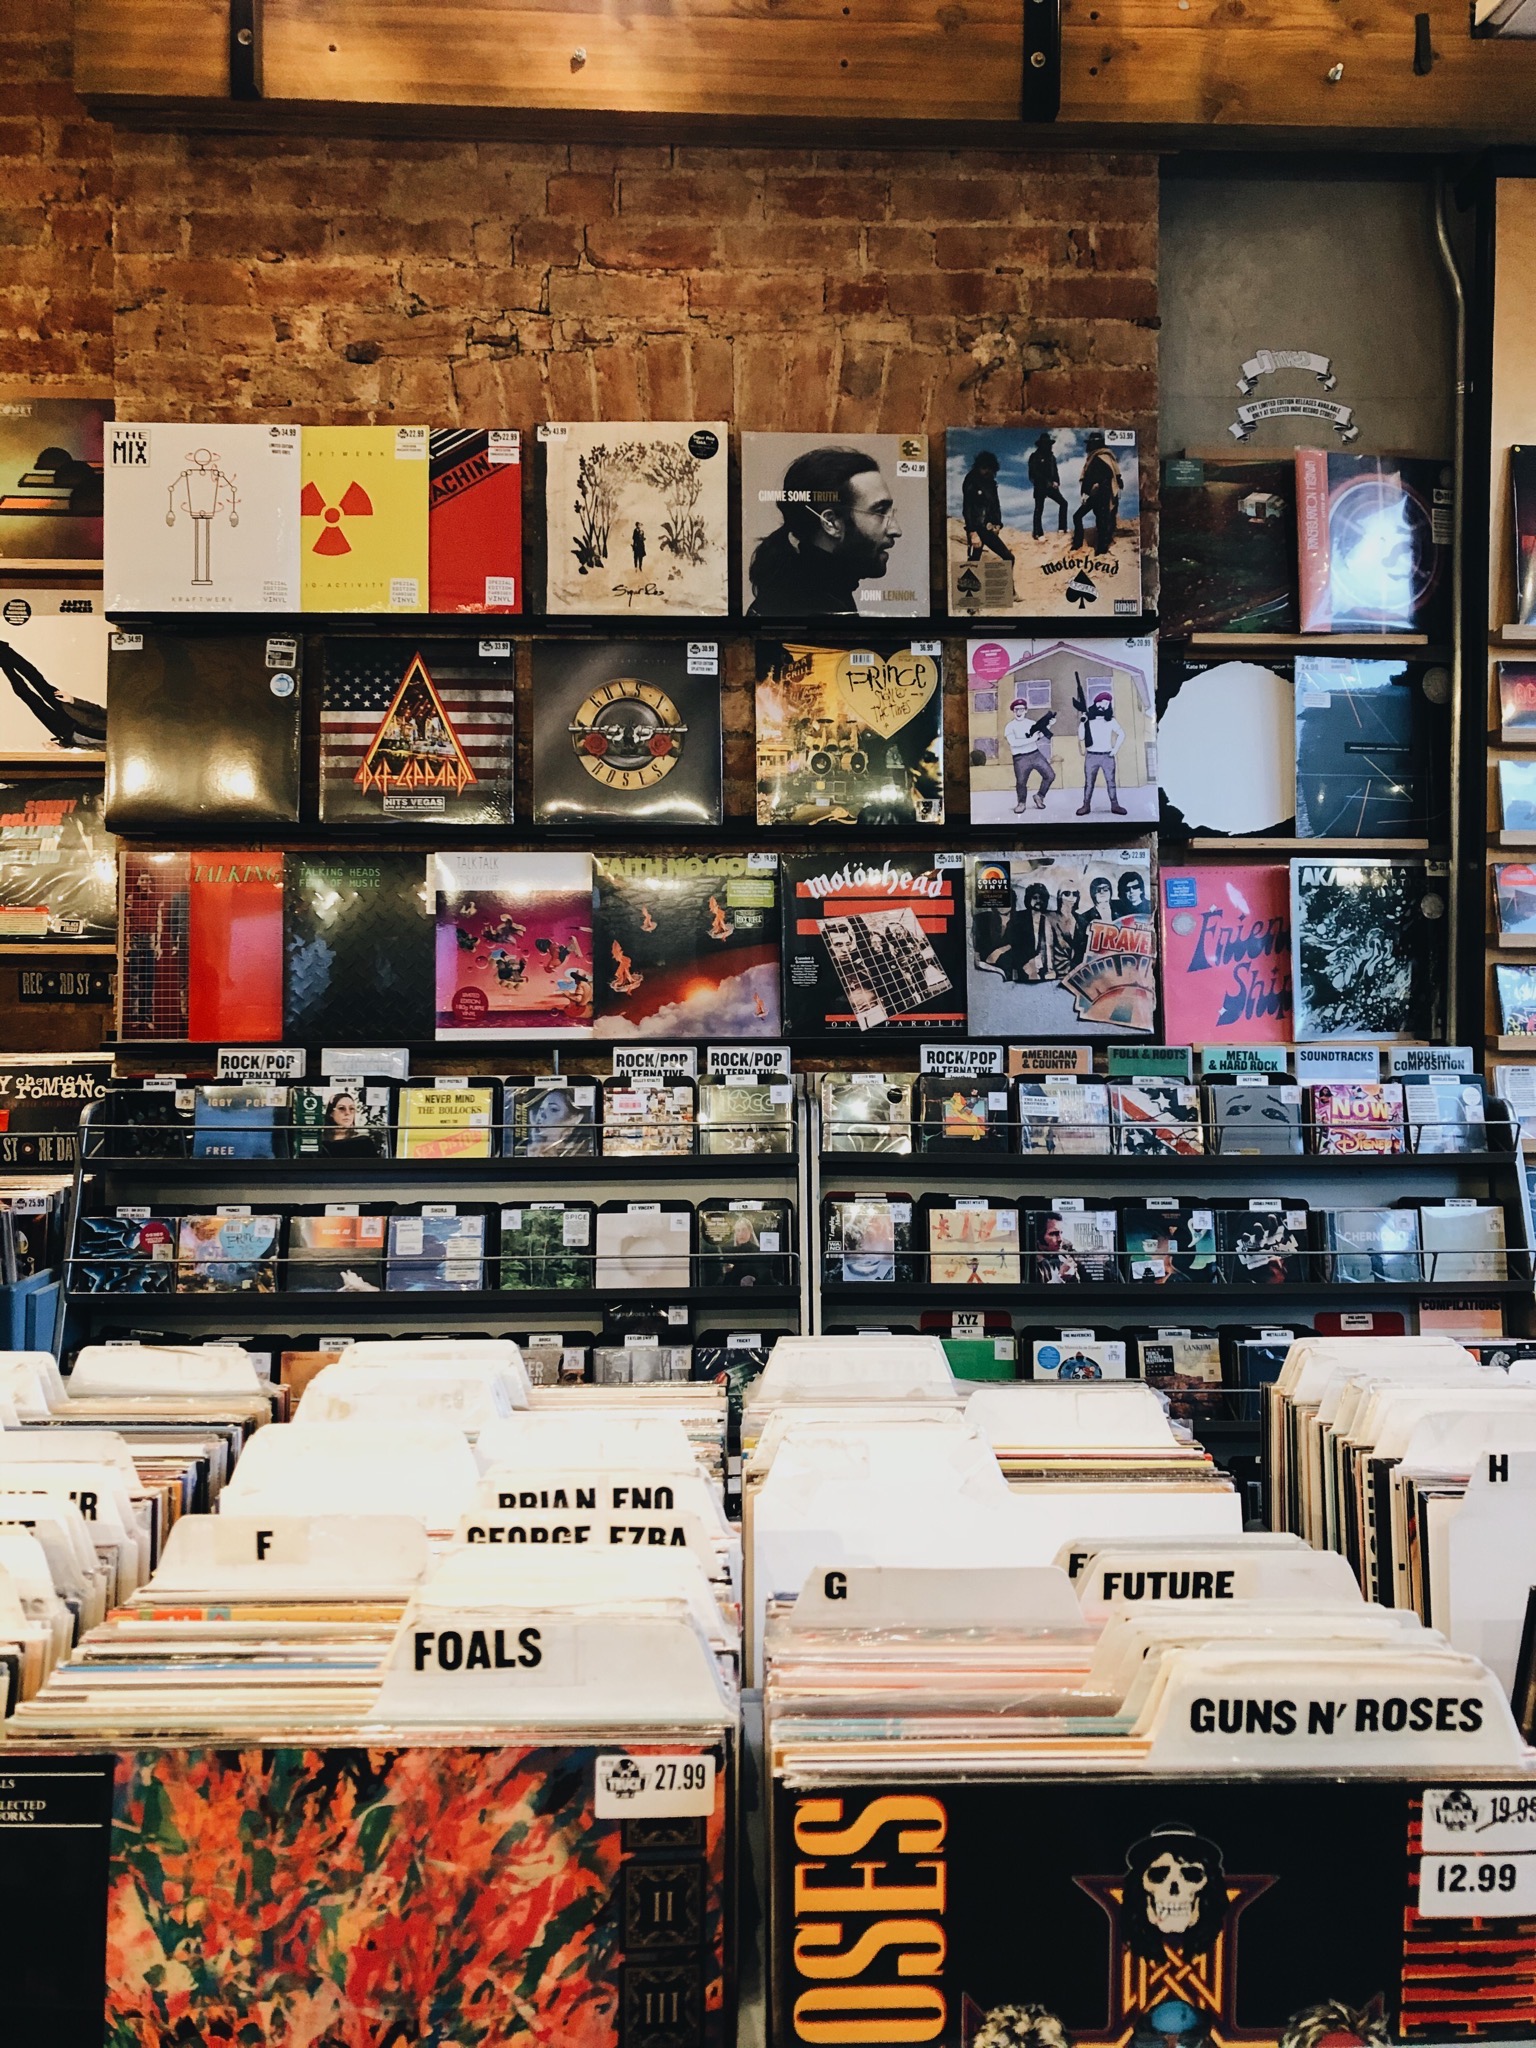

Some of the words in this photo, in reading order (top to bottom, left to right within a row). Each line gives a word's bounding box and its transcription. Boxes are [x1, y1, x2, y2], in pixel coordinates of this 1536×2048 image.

[1246, 405, 1258, 414] VERY
[1258, 400, 1276, 410] LIMITED
[1295, 398, 1317, 407] RELEASES
[1317, 402, 1341, 414] AVAILABLE
[1252, 411, 1263, 420] ONLY
[1263, 408, 1269, 416] AT
[1269, 406, 1290, 415] SELECTED
[1302, 406, 1319, 415] RECORD
[114, 431, 148, 440] THE
[281, 428, 297, 437] 34.99
[409, 430, 425, 438] 22.99
[553, 427, 567, 435] 43.99
[502, 433, 518, 441] 22.99
[113, 441, 148, 464] MIX
[911, 464, 926, 472] 42.99
[432, 455, 503, 502] ACHIN
[758, 490, 787, 502] GIMME
[787, 490, 812, 502] SOME
[812, 491, 841, 502] TRUTH.
[488, 595, 512, 603] VINYL
[860, 590, 882, 601] JOHN
[126, 635, 142, 644] 34.99
[494, 642, 509, 650] 33.99
[919, 643, 934, 652] 36.99
[788, 658, 807, 671] BAR
[1185, 663, 1199, 671] Kate
[1199, 663, 1208, 671] NV
[362, 758, 392, 797] DEF
[396, 758, 469, 797] LEPPARD
[591, 761, 663, 787] ROSES
[385, 798, 408, 806] HITS
[411, 798, 444, 806] VEGAS
[946, 855, 962, 864] 20.99
[1131, 851, 1146, 859] 22.99
[478, 856, 500, 870] TALK
[598, 857, 664, 877] FAITH
[666, 857, 698, 877] NO
[193, 864, 282, 884] TALKING
[299, 867, 344, 877] TALKING
[349, 867, 381, 877] HEADS
[299, 878, 326, 888] FEAR
[330, 878, 344, 888] OF
[349, 878, 381, 888] MUSIC
[485, 874, 500, 886] LIFE
[831, 1020, 852, 1028] ON
[885, 1020, 957, 1028] PAROLE
[710, 1052, 783, 1067] ROCK/POP
[926, 1050, 998, 1065] ROCK/POP
[1021, 1050, 1078, 1060] AMERICANA
[1112, 1048, 1140, 1060] FOLK
[1141, 1048, 1151, 1060] &
[1152, 1048, 1187, 1060] ROOTS
[1226, 1050, 1260, 1061] METAL
[1300, 1050, 1374, 1062] SOUNDTRACKS
[1407, 1051, 1451, 1061] MODERN
[220, 1055, 296, 1070] ROCK/POP
[615, 1053, 689, 1068] ROCK/POP
[1021, 1059, 1030, 1069] &
[1032, 1059, 1077, 1070] COUNTRY
[1208, 1060, 1217, 1070] &
[1219, 1060, 1248, 1071] HARD
[1250, 1060, 1278, 1071] ROCK
[1394, 1060, 1465, 1071] COMPOSITION
[224, 1071, 292, 1079] ALTERNATIVE
[619, 1069, 685, 1077] ALTERNATIVE
[929, 1066, 994, 1074] ALTERNATIVE
[208, 1098, 233, 1107] IGGY
[245, 1098, 267, 1107] POP
[425, 1094, 453, 1104] NEVER
[455, 1094, 475, 1103] MIND
[417, 1106, 435, 1115] THE
[438, 1106, 482, 1115] BOLLOCKS
[1331, 1098, 1390, 1120] NOW
[206, 1146, 235, 1155] FREE
[565, 1213, 588, 1221] SPICE
[1421, 1298, 1500, 1311] COMPILATIONS
[957, 1314, 978, 1326] XYZ
[1488, 1454, 1509, 1483] H
[256, 1531, 274, 1560] F
[824, 1571, 848, 1600] G
[1103, 1570, 1235, 1601] FUTURE
[414, 1627, 542, 1672] FOALS
[1190, 1698, 1297, 1735] GUNS
[1308, 1701, 1347, 1735] N'
[1355, 1697, 1483, 1732] ROSES
[654, 1763, 706, 1792] 27.99
[1437, 1863, 1517, 1893] 12.99
[653, 1891, 674, 1923] II
[645, 1991, 679, 2024] III
